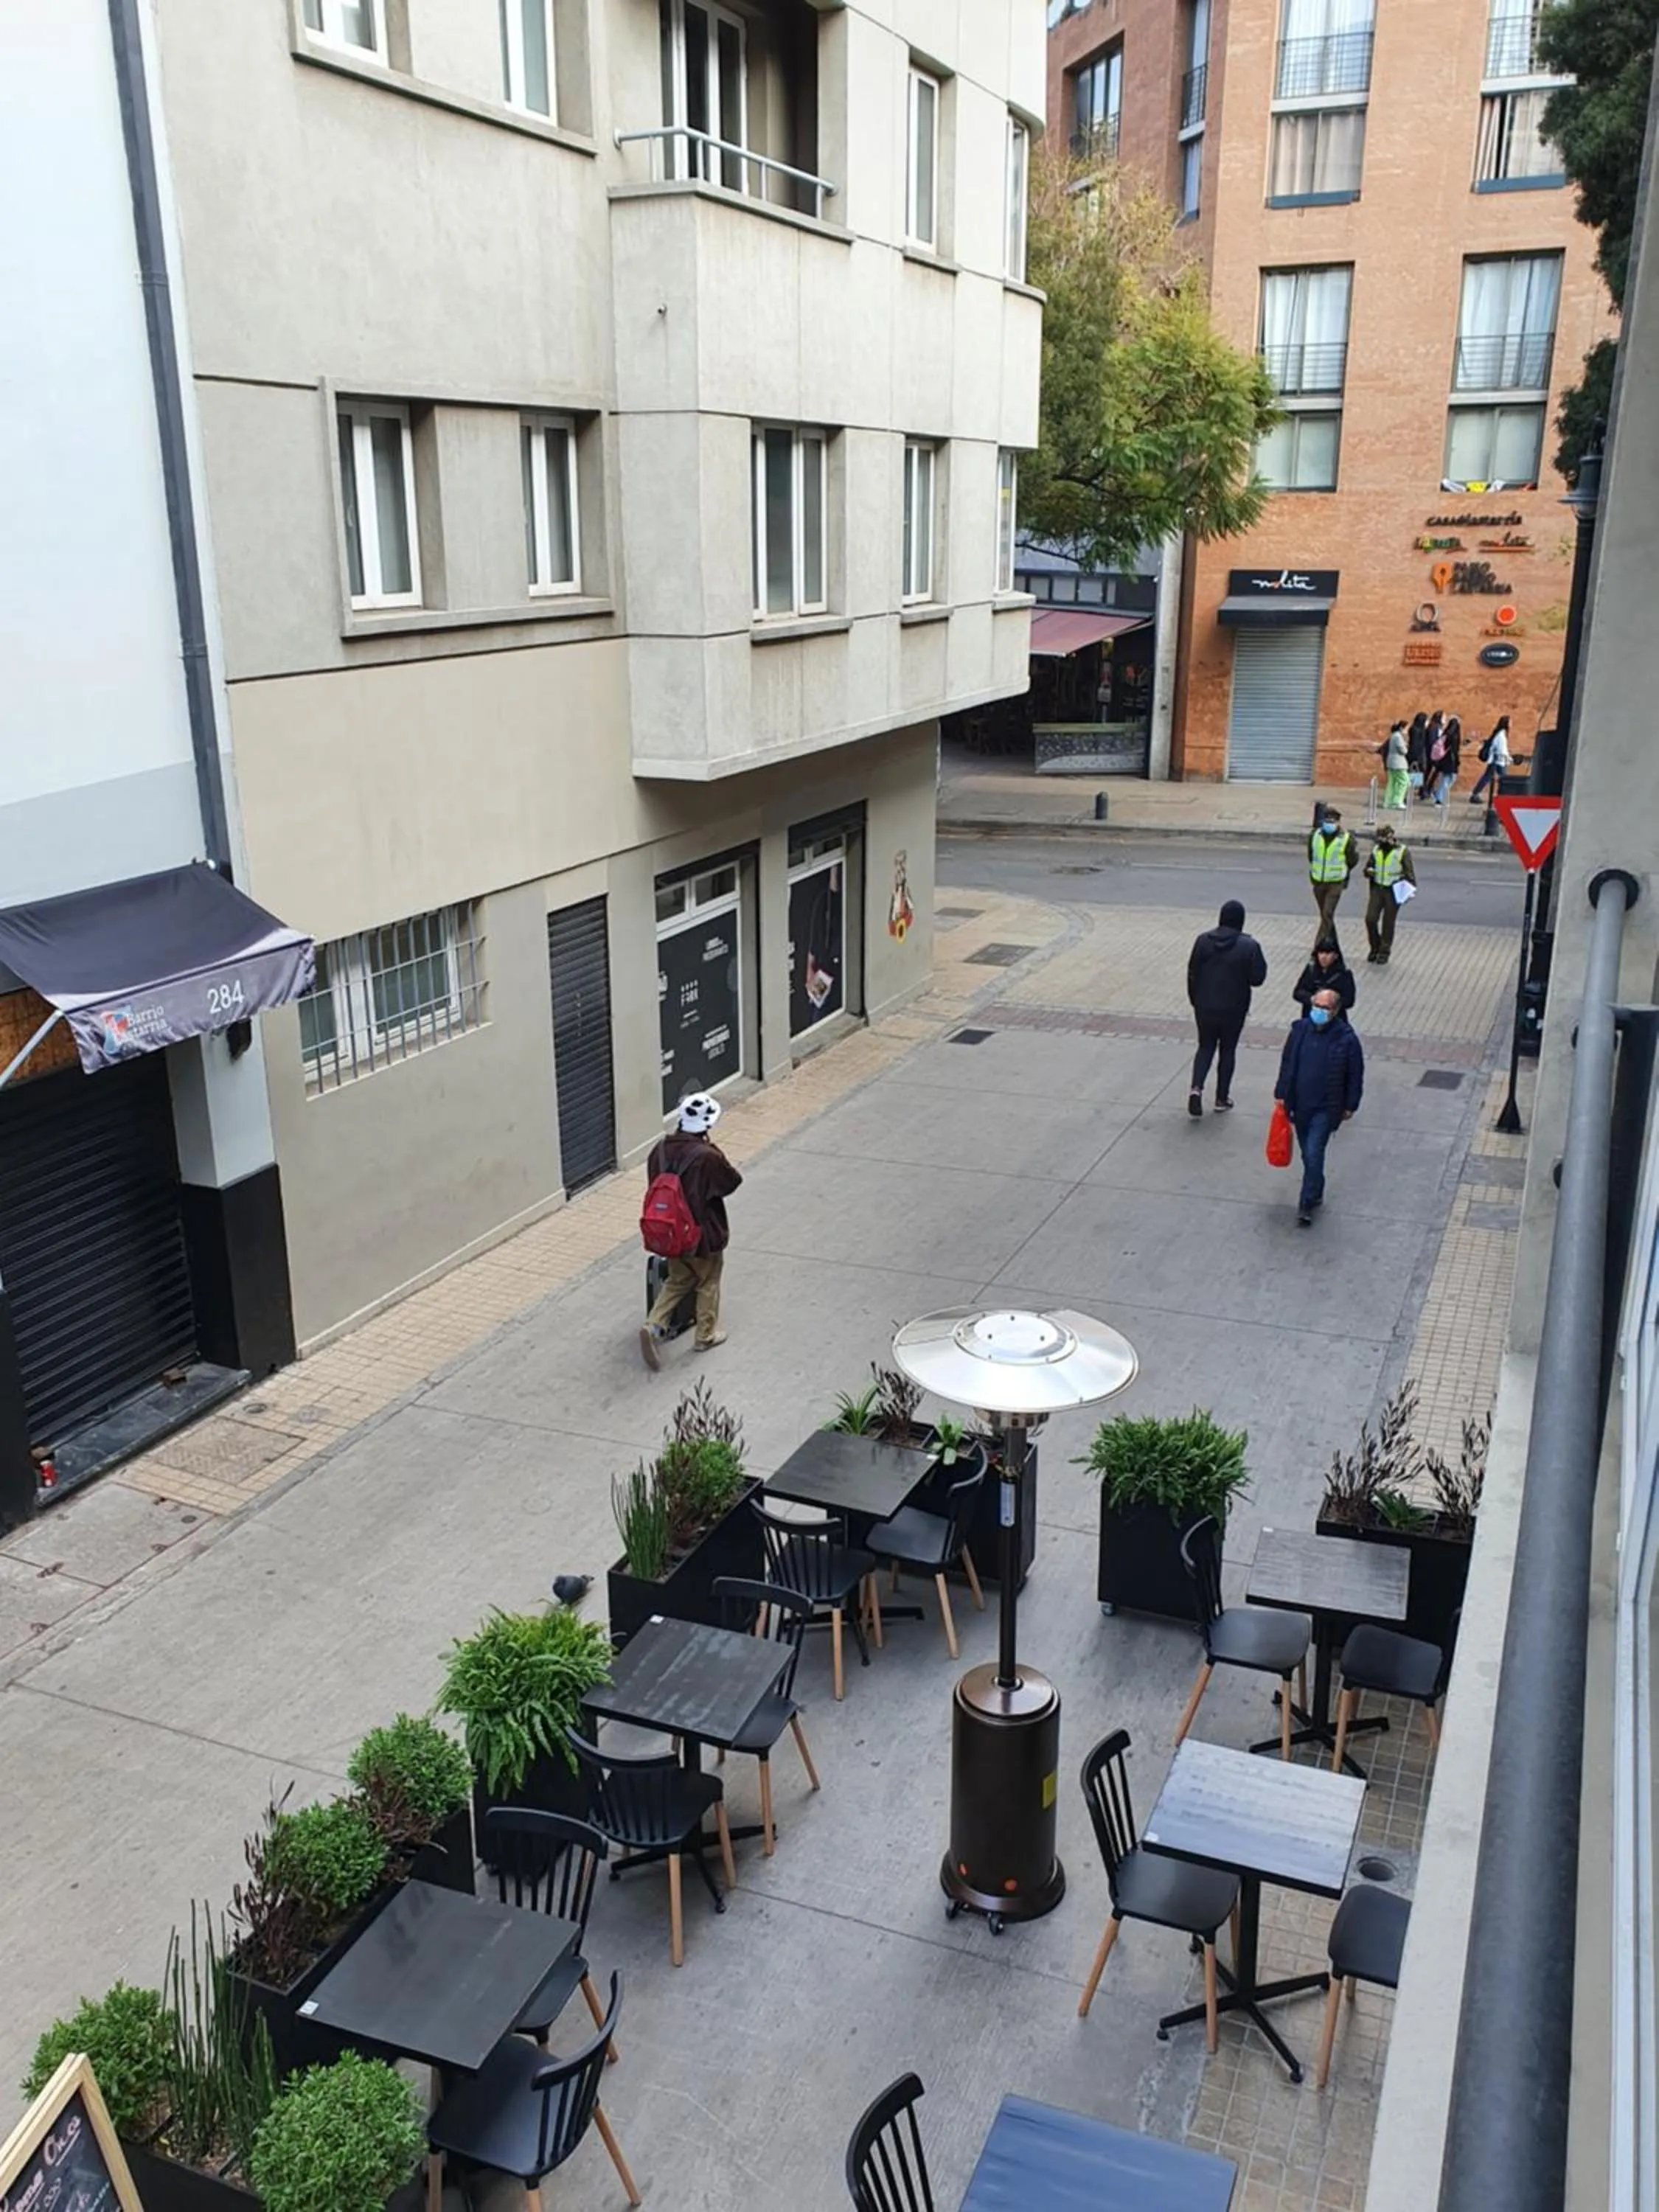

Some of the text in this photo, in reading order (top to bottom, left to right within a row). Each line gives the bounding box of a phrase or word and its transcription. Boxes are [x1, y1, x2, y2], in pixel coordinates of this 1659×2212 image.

[1251, 569, 1317, 591] nolita
[206, 979, 245, 1015] 284
[126, 1004, 164, 1027] Barrio
